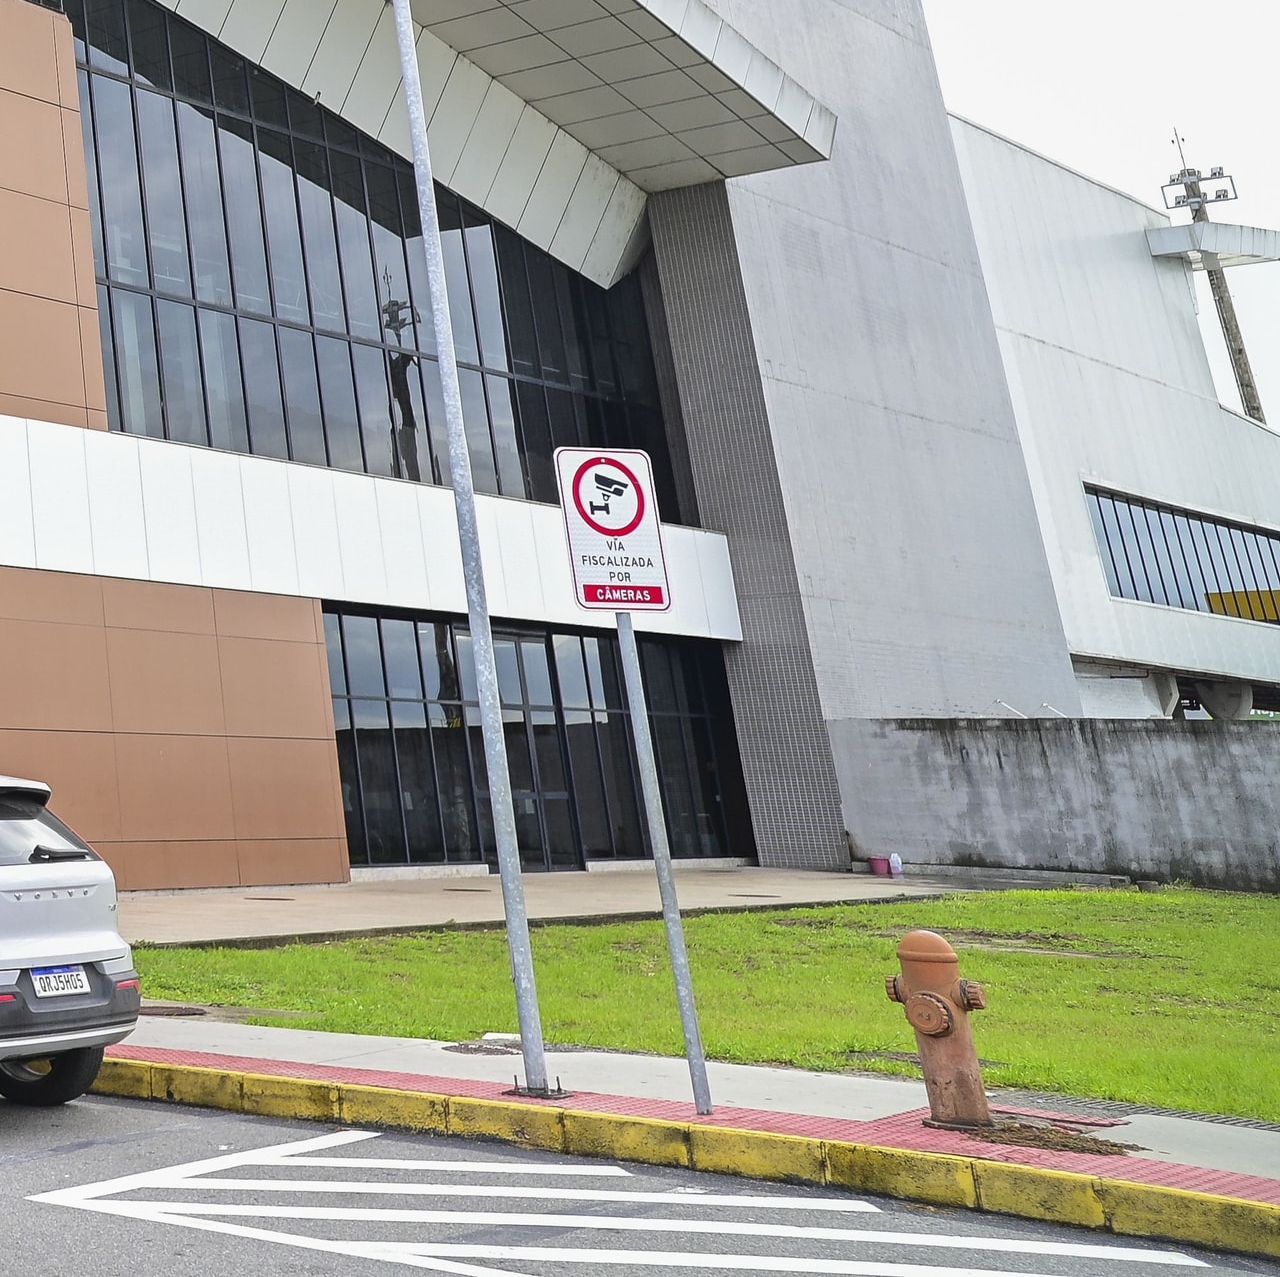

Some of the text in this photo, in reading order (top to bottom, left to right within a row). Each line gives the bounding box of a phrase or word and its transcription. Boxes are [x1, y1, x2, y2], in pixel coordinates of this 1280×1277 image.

[581, 555, 654, 568] FISCALIZADA
[609, 571, 632, 583] POR
[596, 586, 651, 601] CÂMERAS
[13, 887, 89, 901] VOLVO
[38, 973, 84, 993] QRJ5H05
